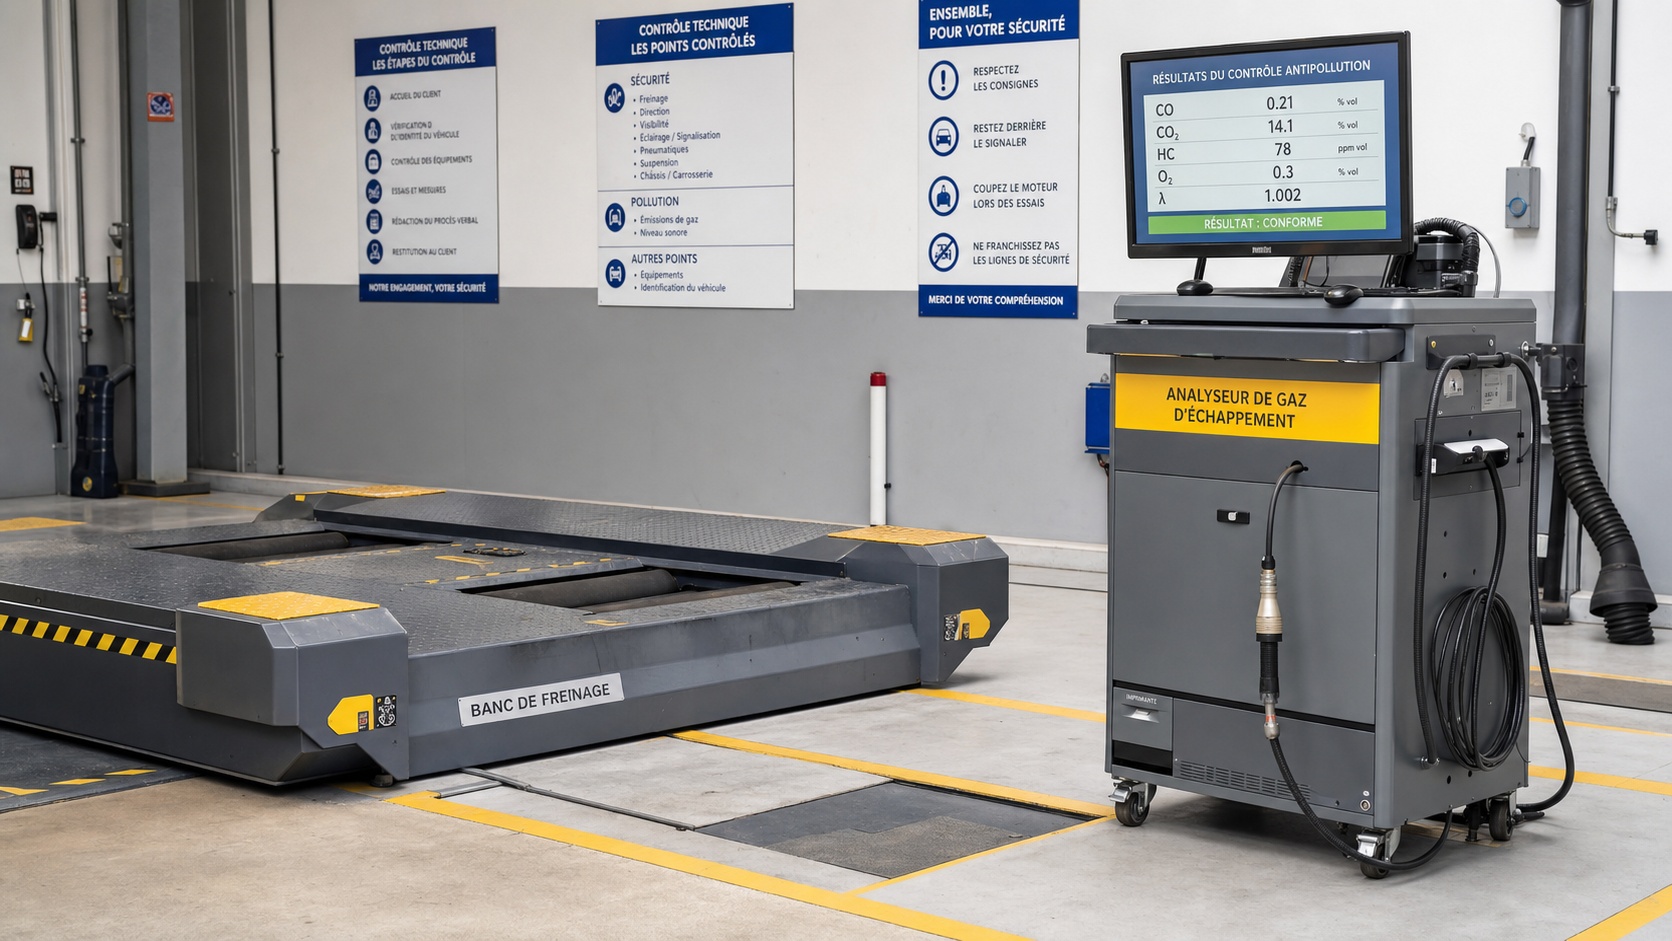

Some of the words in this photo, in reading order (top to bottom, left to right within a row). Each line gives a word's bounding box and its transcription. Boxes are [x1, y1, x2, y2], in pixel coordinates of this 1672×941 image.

[930, 4, 992, 21] ENSEMBLE,
[639, 18, 690, 36] CONTRÔLE
[692, 16, 749, 33] TECHNIQUE
[930, 26, 962, 40] POUR
[966, 23, 1004, 37] VOTRE
[1008, 15, 1065, 34] SÉCURITÉ
[380, 39, 421, 54] CONTRÔLE
[422, 37, 468, 50] TECHNIQUE
[631, 42, 648, 56] LES
[650, 39, 689, 54] POINTS
[691, 33, 756, 52] CONTRÔLÉS
[372, 59, 386, 70] LES
[388, 56, 416, 69] ÉTAPES
[418, 56, 429, 66] DU
[432, 50, 476, 66] CONTRÔLE
[974, 65, 1019, 76] RESPECTEZ
[1152, 70, 1207, 85] RÉSULTATS
[1210, 70, 1225, 80] DU
[1228, 64, 1282, 79] CONTRÔLE
[1285, 60, 1370, 76] ANTIPOLLUTION
[630, 72, 670, 86] SÉCURITÉ
[974, 81, 987, 91] LES
[990, 79, 1039, 90] CONSIGNES
[390, 92, 412, 100] ACCUEIL
[422, 90, 441, 98] CLIENT
[640, 95, 668, 104] Freinage
[640, 107, 670, 116] Direction
[1156, 104, 1174, 117] CO
[1267, 96, 1294, 110] 0.21
[1337, 98, 1345, 106] %
[1346, 97, 1358, 106] vol
[974, 122, 1004, 133] RESTEZ
[1007, 119, 1046, 131] DERRIÈRE
[1268, 119, 1293, 134] 14.1
[1346, 120, 1358, 129] vol
[974, 138, 983, 148] LE
[985, 138, 1027, 148] SIGNALER
[640, 146, 688, 155] Pneumatiques
[1157, 148, 1175, 160] HC
[1275, 142, 1291, 156] 78
[1338, 144, 1354, 154] ppm
[1356, 143, 1367, 151] vol
[391, 156, 420, 166] CONTRÔLE
[673, 170, 713, 179] Carrosserie
[1273, 166, 1294, 179] 0.3
[1347, 167, 1358, 176] vol
[974, 183, 1007, 193] COUPEZ
[1010, 183, 1019, 192] LE
[1022, 182, 1058, 192] MOTEUR
[631, 196, 679, 207] POLLUTION
[974, 198, 995, 208] LORS
[998, 198, 1014, 208] DES
[1016, 198, 1045, 208] ESSAIS
[1159, 193, 1166, 205] λ
[1265, 188, 1301, 202] 1.002
[640, 215, 674, 224] Émissions
[675, 215, 684, 223] de
[686, 216, 698, 225] gaz
[1204, 216, 1254, 229] RÉSULTAT
[1262, 216, 1323, 228] CONFORME
[973, 241, 984, 250] NE
[986, 241, 1042, 251] FRANCHISSEZ
[1045, 241, 1060, 250] PAS
[632, 254, 663, 264] AUTRES
[665, 254, 698, 263] POINTS
[973, 254, 986, 265] LES
[989, 254, 1017, 264] LIGNES
[1020, 255, 1030, 264] DE
[1032, 252, 1070, 265] SÉCURITÉ
[369, 283, 389, 292] NOTRE
[390, 284, 434, 292] ENGAGEMENT,
[435, 284, 455, 292] VOTRE
[457, 282, 486, 292] SÉCURITÉ
[687, 284, 696, 292] du
[697, 284, 726, 292] véhicule
[929, 294, 952, 305] MERCI
[954, 295, 964, 305] DE
[967, 295, 993, 305] VOTRE
[995, 293, 1063, 305] COMPRÉHENSION
[1166, 386, 1250, 406] ANALYSEUR
[1254, 390, 1274, 406] DE
[1276, 392, 1308, 408] GAZ
[1174, 405, 1296, 428] D'ÉCHAPPEMENT
[471, 698, 514, 718] BANC
[518, 694, 537, 709] DE
[542, 683, 610, 706] FREINAGE
